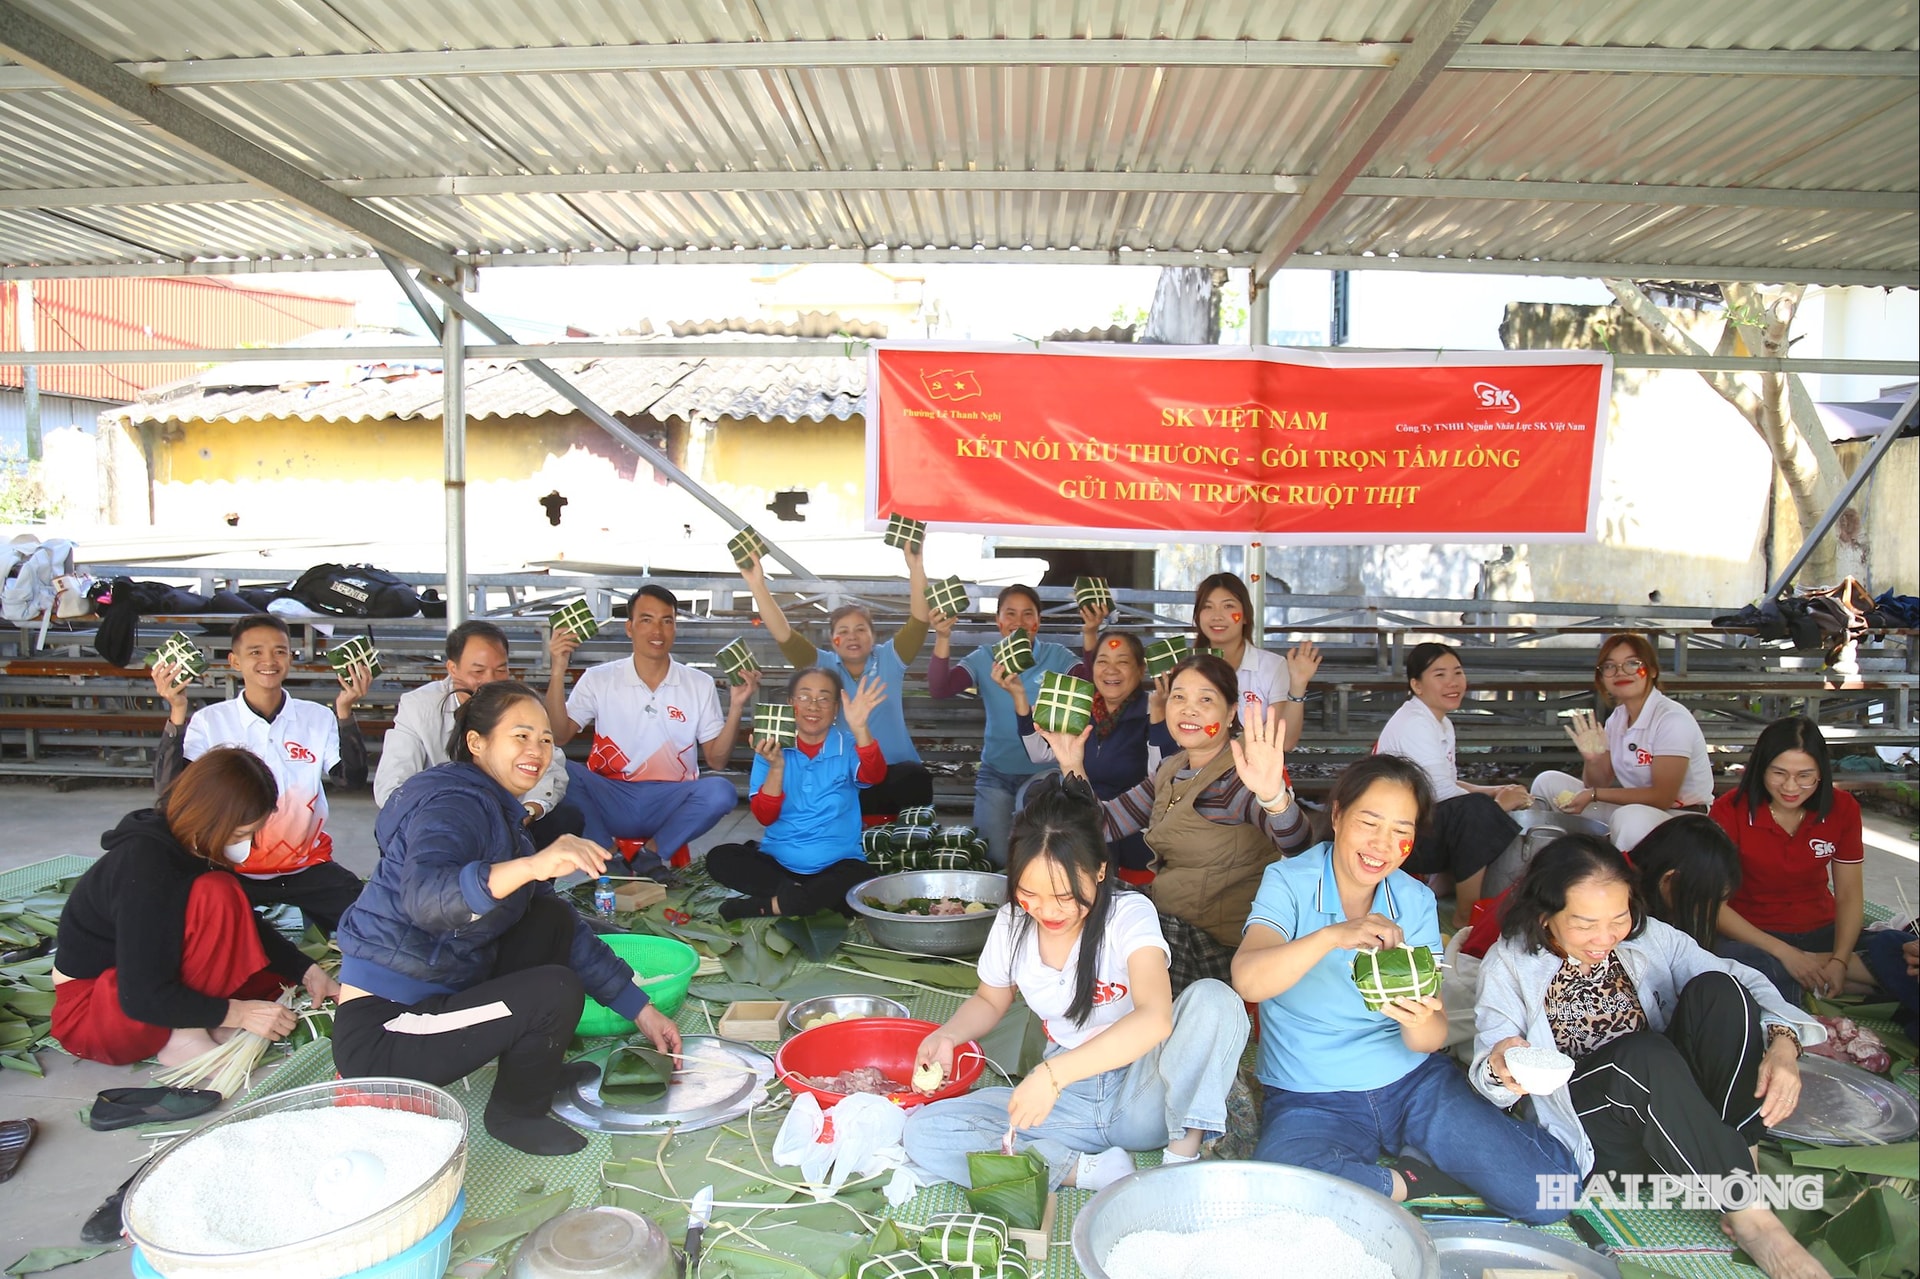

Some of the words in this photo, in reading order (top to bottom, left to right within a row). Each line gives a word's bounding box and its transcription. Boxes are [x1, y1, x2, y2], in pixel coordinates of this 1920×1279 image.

[951, 409, 978, 419] Thanh
[981, 411, 1001, 422] Nghị
[1161, 407, 1195, 427] SK
[1202, 406, 1264, 433] VIỆT
[1270, 410, 1329, 431] NAM
[1395, 423, 1419, 433] Công
[1420, 423, 1432, 433] Ty
[1434, 422, 1465, 431] TNHH
[1466, 420, 1494, 432] Nguồn
[1496, 422, 1514, 431] Nhân
[1516, 422, 1532, 432] Lực
[1534, 422, 1547, 431] SK
[1549, 422, 1566, 432] Việt
[1567, 422, 1586, 431] Nam
[956, 433, 1008, 459] KẾT
[1013, 436, 1061, 461] NỐI
[1066, 437, 1119, 463] YÊU
[1125, 443, 1240, 466] THƯƠNG
[1261, 443, 1309, 468] GÓI
[1314, 449, 1387, 473] TRỌN
[1393, 444, 1450, 468] TẤM
[1452, 444, 1521, 468] LÒNG
[1058, 475, 1108, 500] GỬI
[1114, 477, 1182, 502] MIỀN
[1189, 482, 1281, 505] TRUNG
[1287, 483, 1359, 510] RUỘT
[1364, 485, 1421, 509] THỊT
